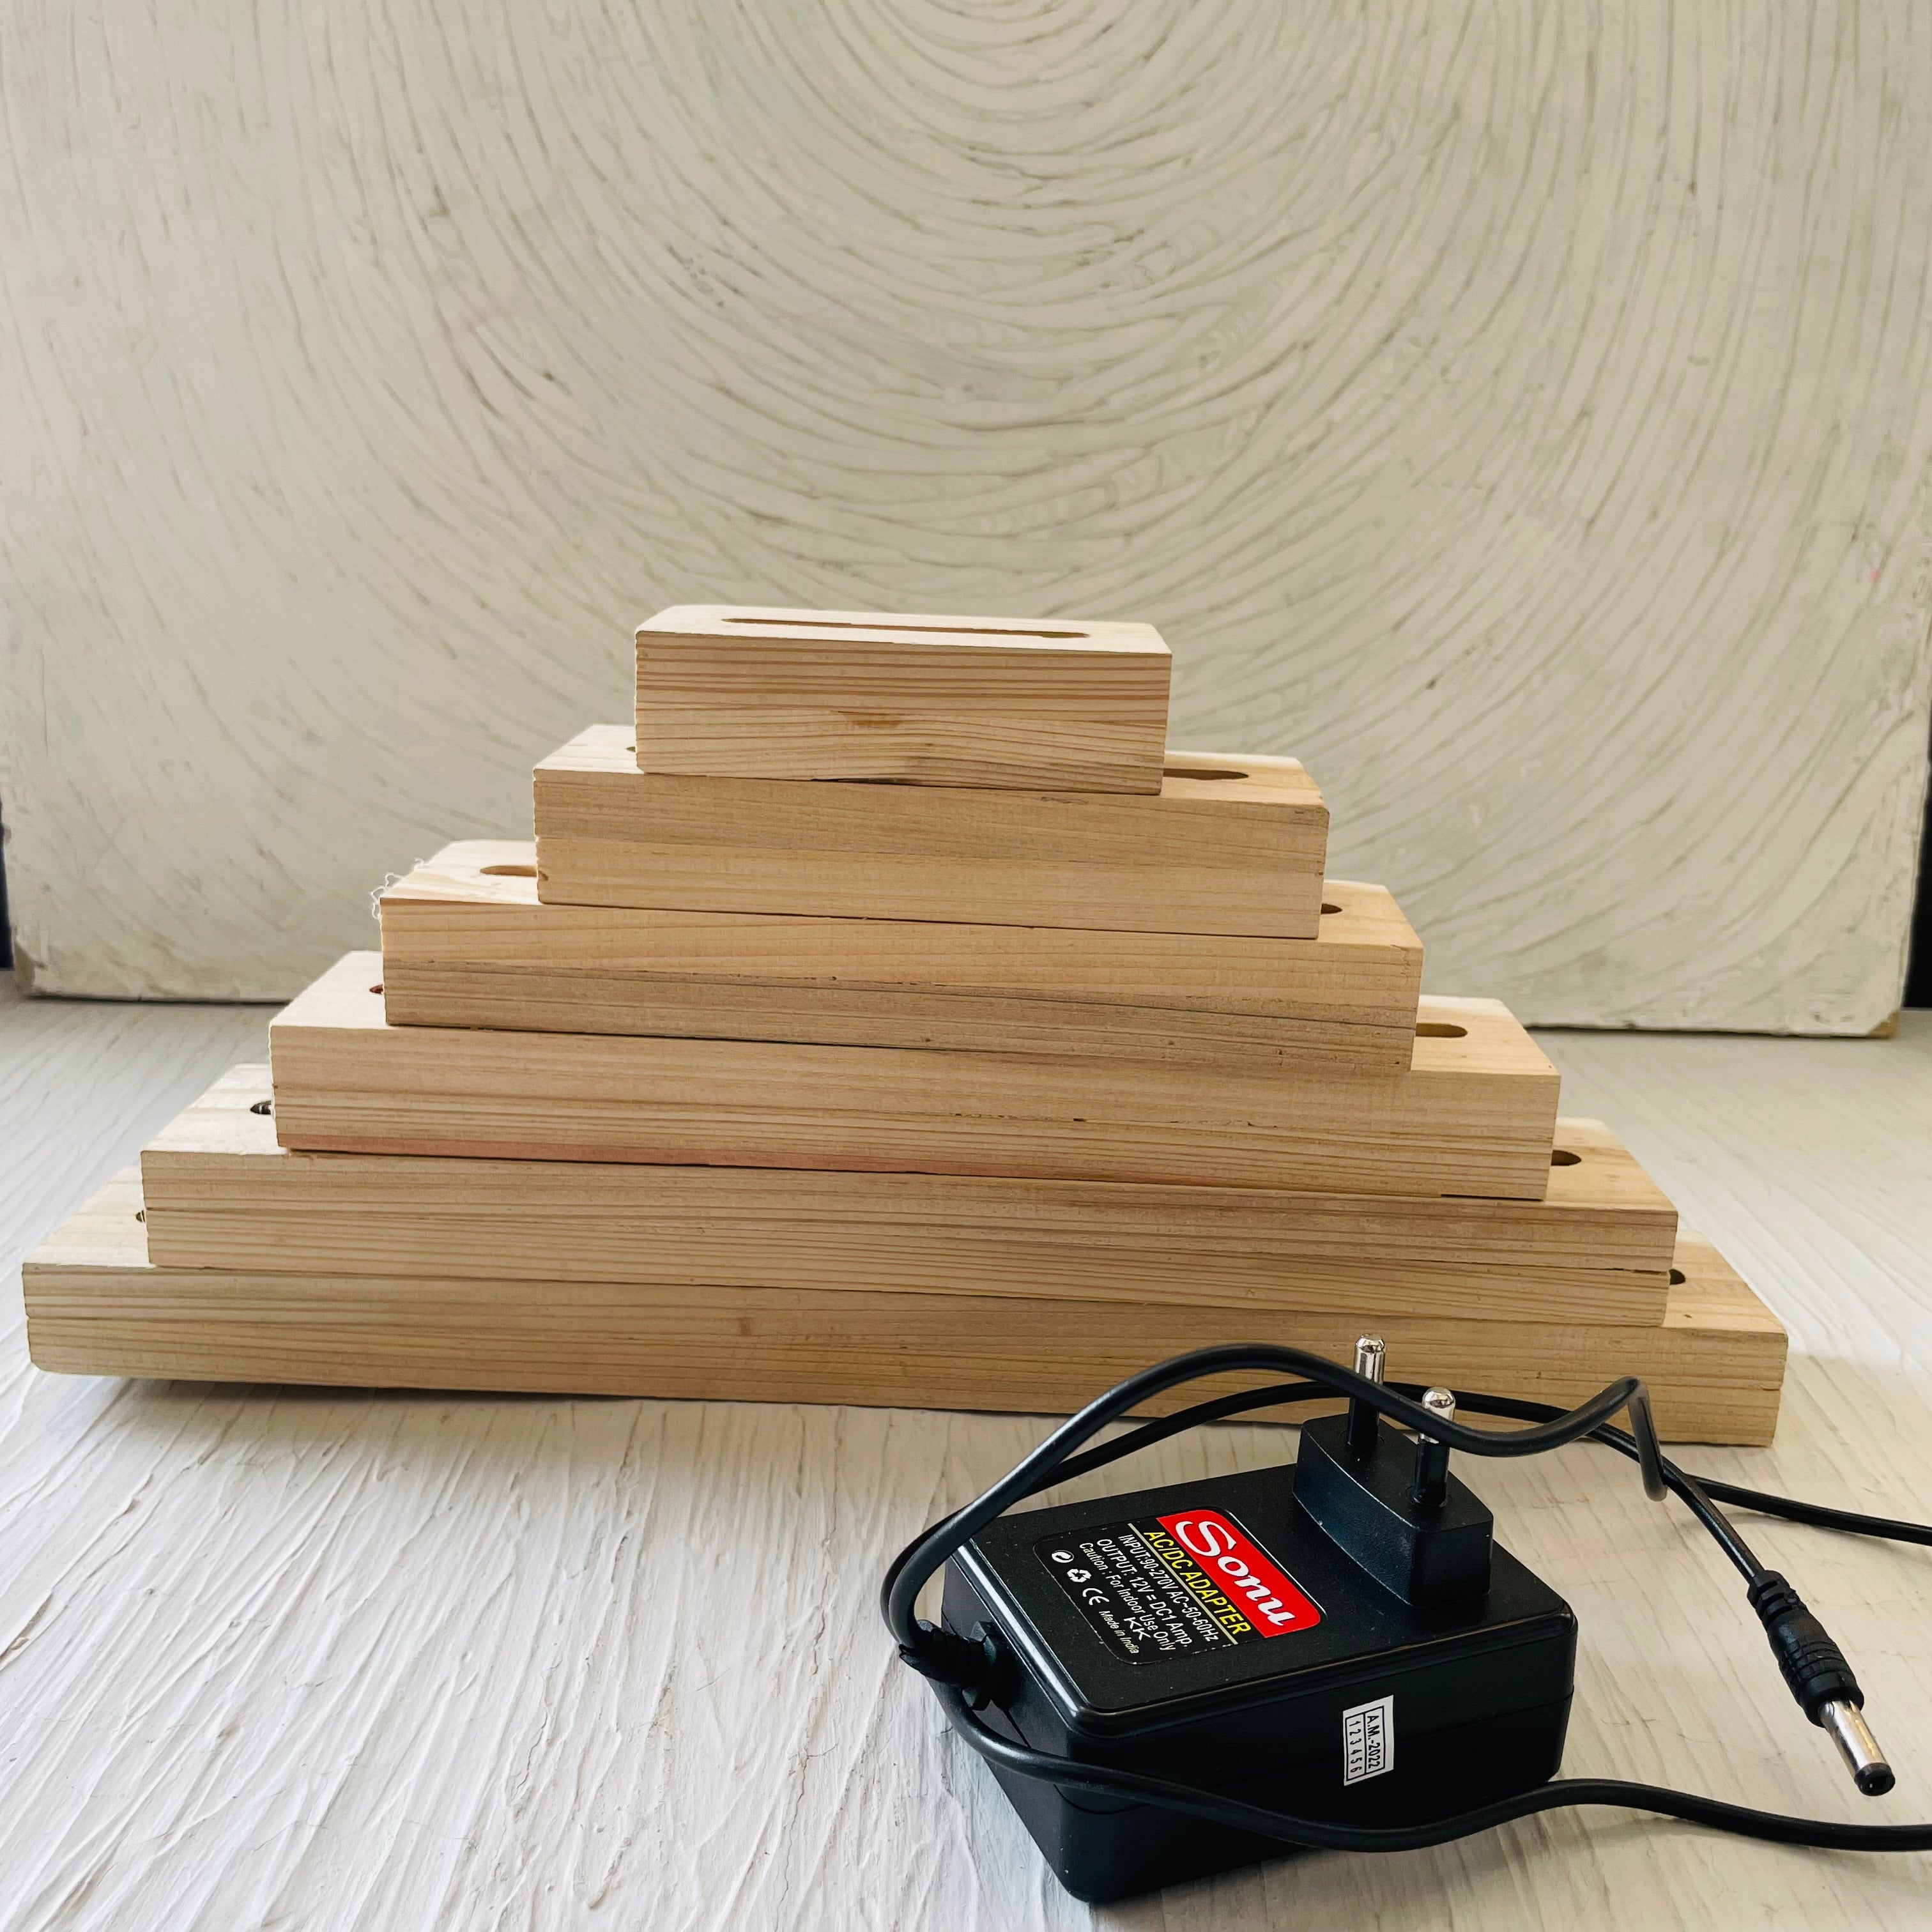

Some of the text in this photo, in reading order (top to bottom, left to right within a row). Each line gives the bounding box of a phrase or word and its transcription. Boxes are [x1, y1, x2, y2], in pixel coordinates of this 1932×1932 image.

[1079, 1542, 1108, 1570] Caution
[1105, 1574, 1124, 1588] For
[1117, 1588, 1146, 1614] Indoor
[1139, 1614, 1158, 1630] Use
[1153, 1631, 1176, 1651] Only
[1096, 1538, 1137, 1575] OUTPUT:
[1129, 1576, 1154, 1592] 12V
[1149, 1601, 1177, 1621] DC1
[1165, 1623, 1193, 1647] Amp.
[1144, 1531, 1252, 1634] AC/DC ADAPTER
[1176, 1521, 1296, 1626] Sonu
[1099, 1611, 1119, 1629] Made
[1120, 1637, 1140, 1653] India
[1123, 1616, 1151, 1641] KK
